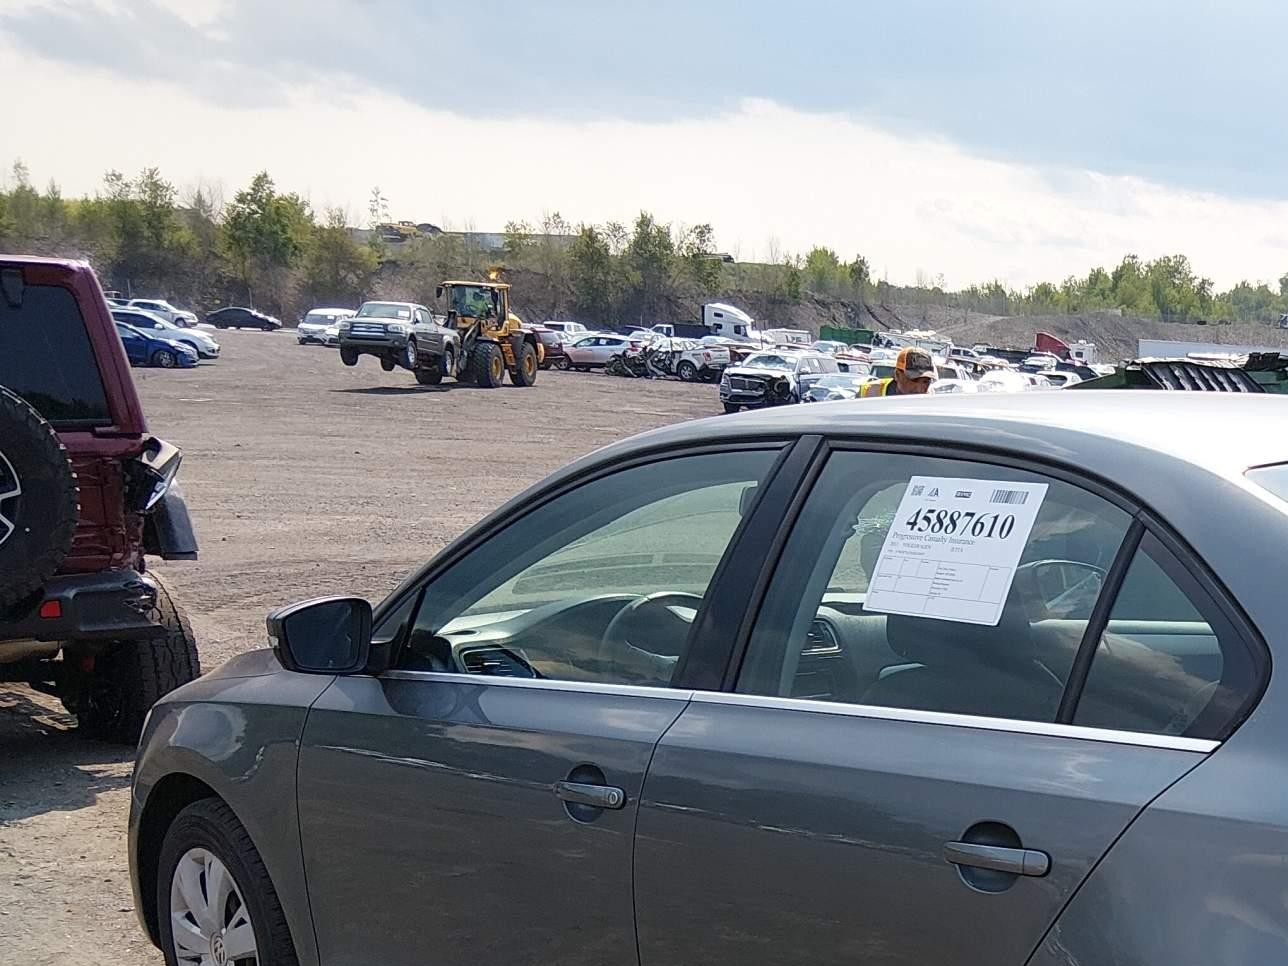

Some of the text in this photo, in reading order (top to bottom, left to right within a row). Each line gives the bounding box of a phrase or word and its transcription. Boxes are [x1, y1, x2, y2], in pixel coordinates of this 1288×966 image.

[906, 508, 1015, 539] 45887610
[892, 532, 923, 542] Progressive
[948, 537, 976, 545] Insurance
